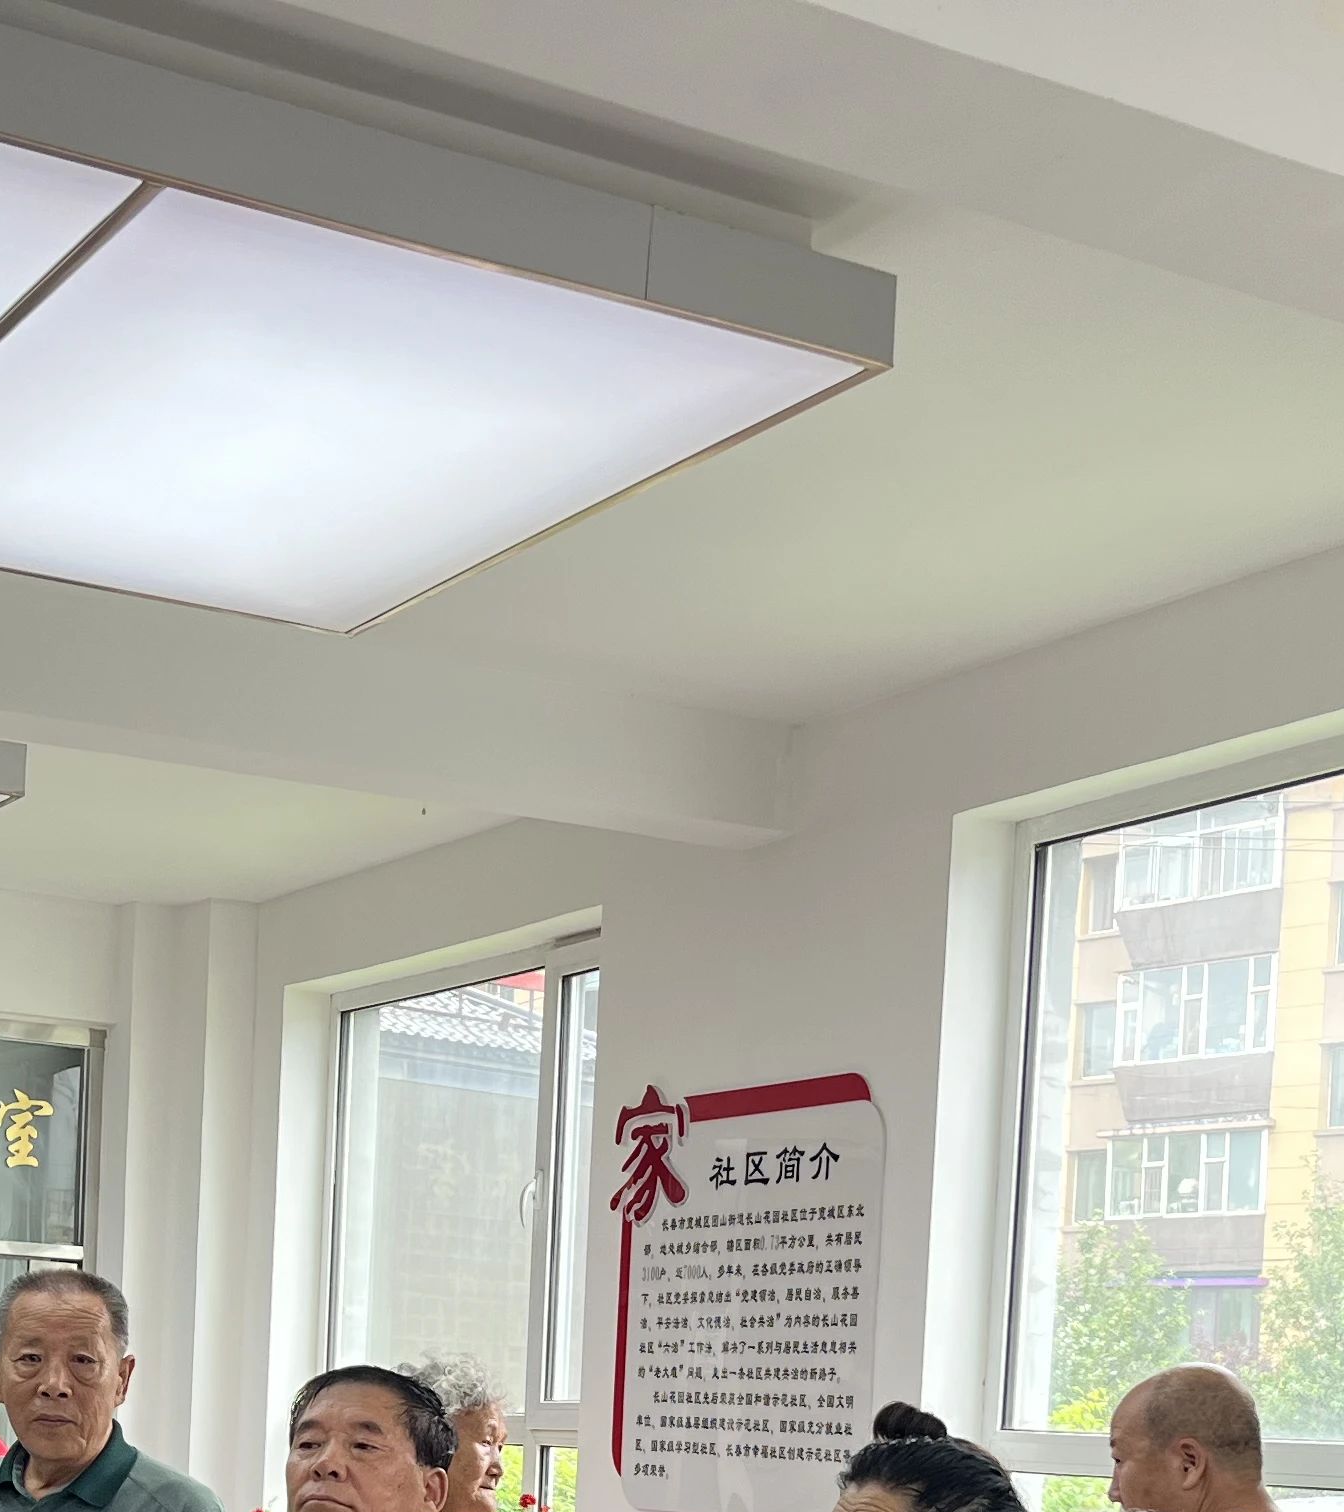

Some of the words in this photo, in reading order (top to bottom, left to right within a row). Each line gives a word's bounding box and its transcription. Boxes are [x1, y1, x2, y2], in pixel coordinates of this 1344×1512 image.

[610, 1084, 688, 1222] 家
[709, 1142, 840, 1190] 社区简介
